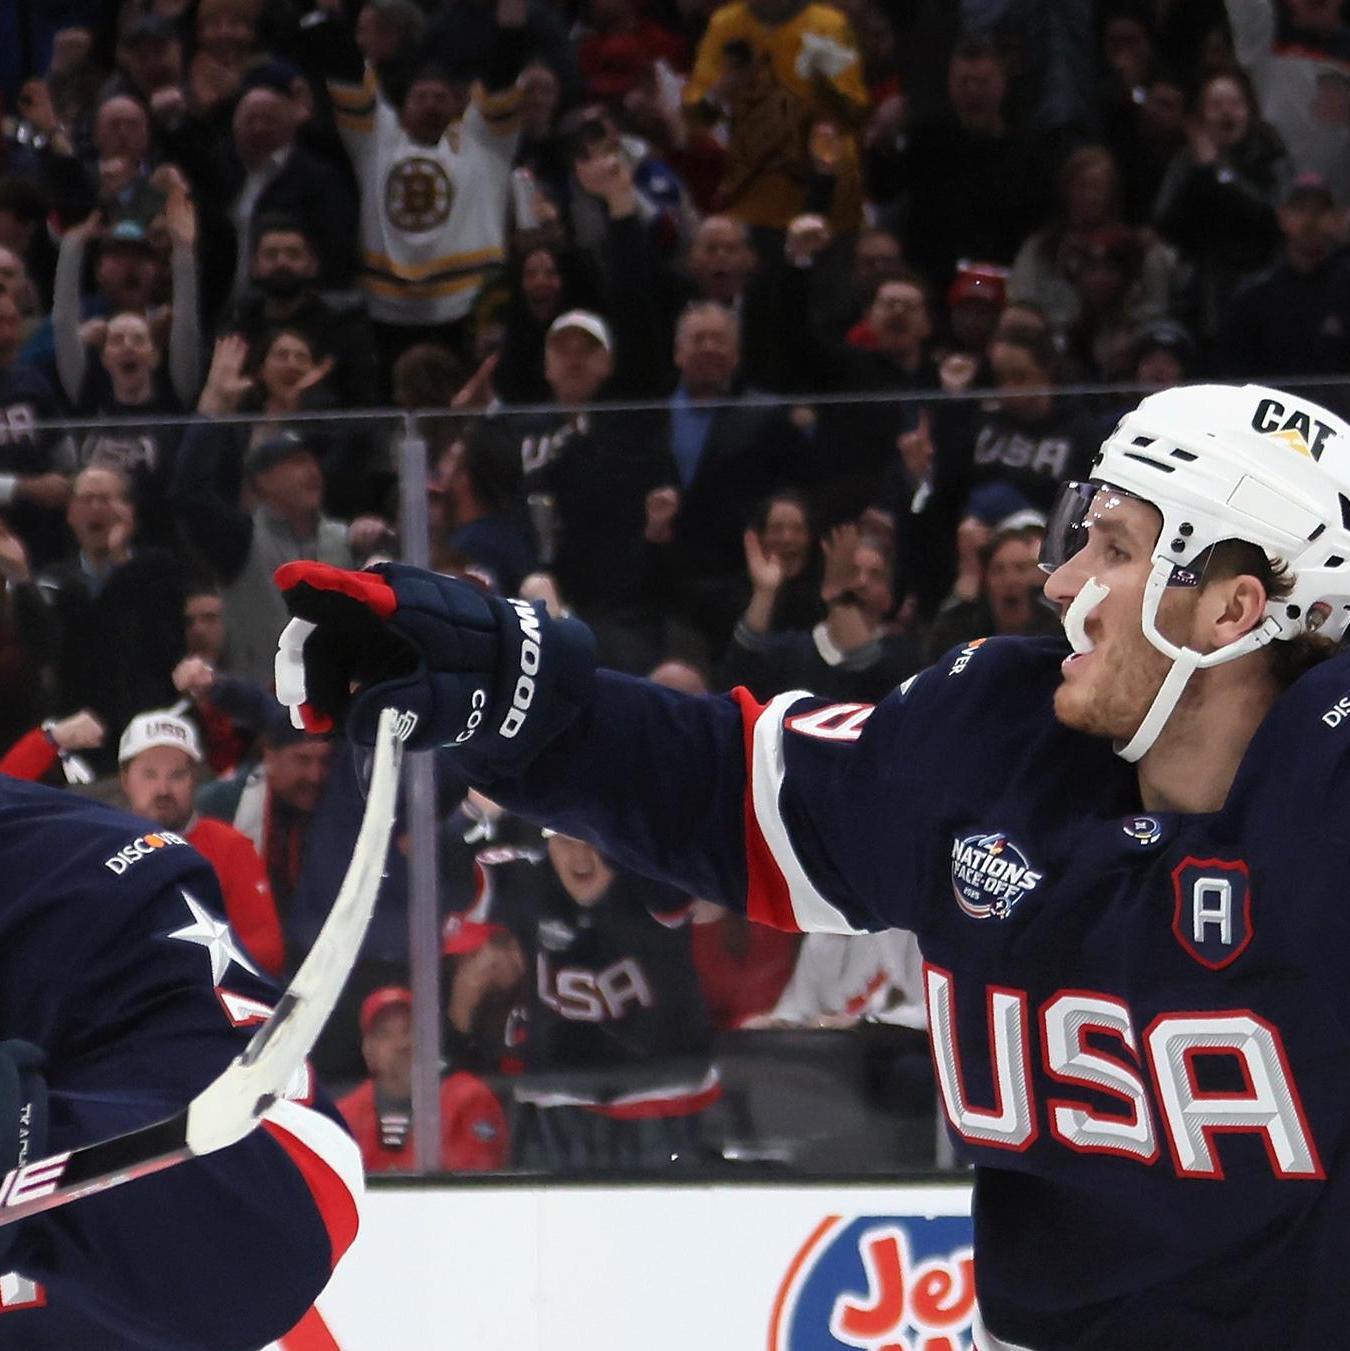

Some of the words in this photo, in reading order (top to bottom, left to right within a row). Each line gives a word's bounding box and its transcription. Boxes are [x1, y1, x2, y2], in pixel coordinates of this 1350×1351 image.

[974, 427, 1072, 470] USA
[1251, 398, 1337, 463] CAT
[499, 598, 542, 739] WOOD
[145, 723, 187, 743] USA
[449, 689, 487, 745] COD
[951, 838, 1042, 890] NATIONS
[1192, 877, 1231, 946] A
[923, 962, 1328, 1182] USA
